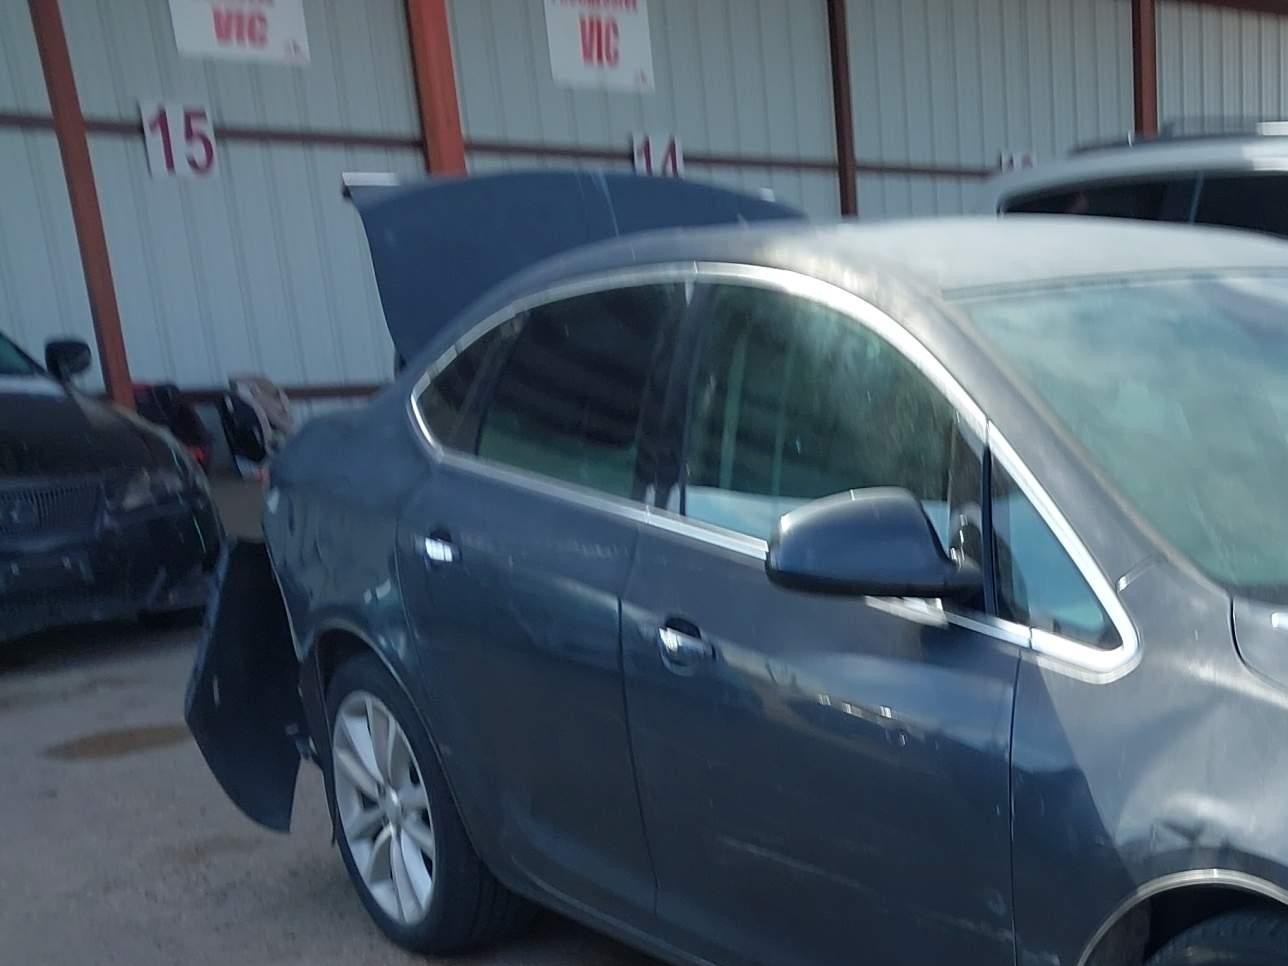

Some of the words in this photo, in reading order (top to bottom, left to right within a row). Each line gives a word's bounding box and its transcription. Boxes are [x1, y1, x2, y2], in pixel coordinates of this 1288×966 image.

[212, 9, 268, 48] VIC
[579, 17, 620, 69] VIC
[149, 104, 214, 176] 15
